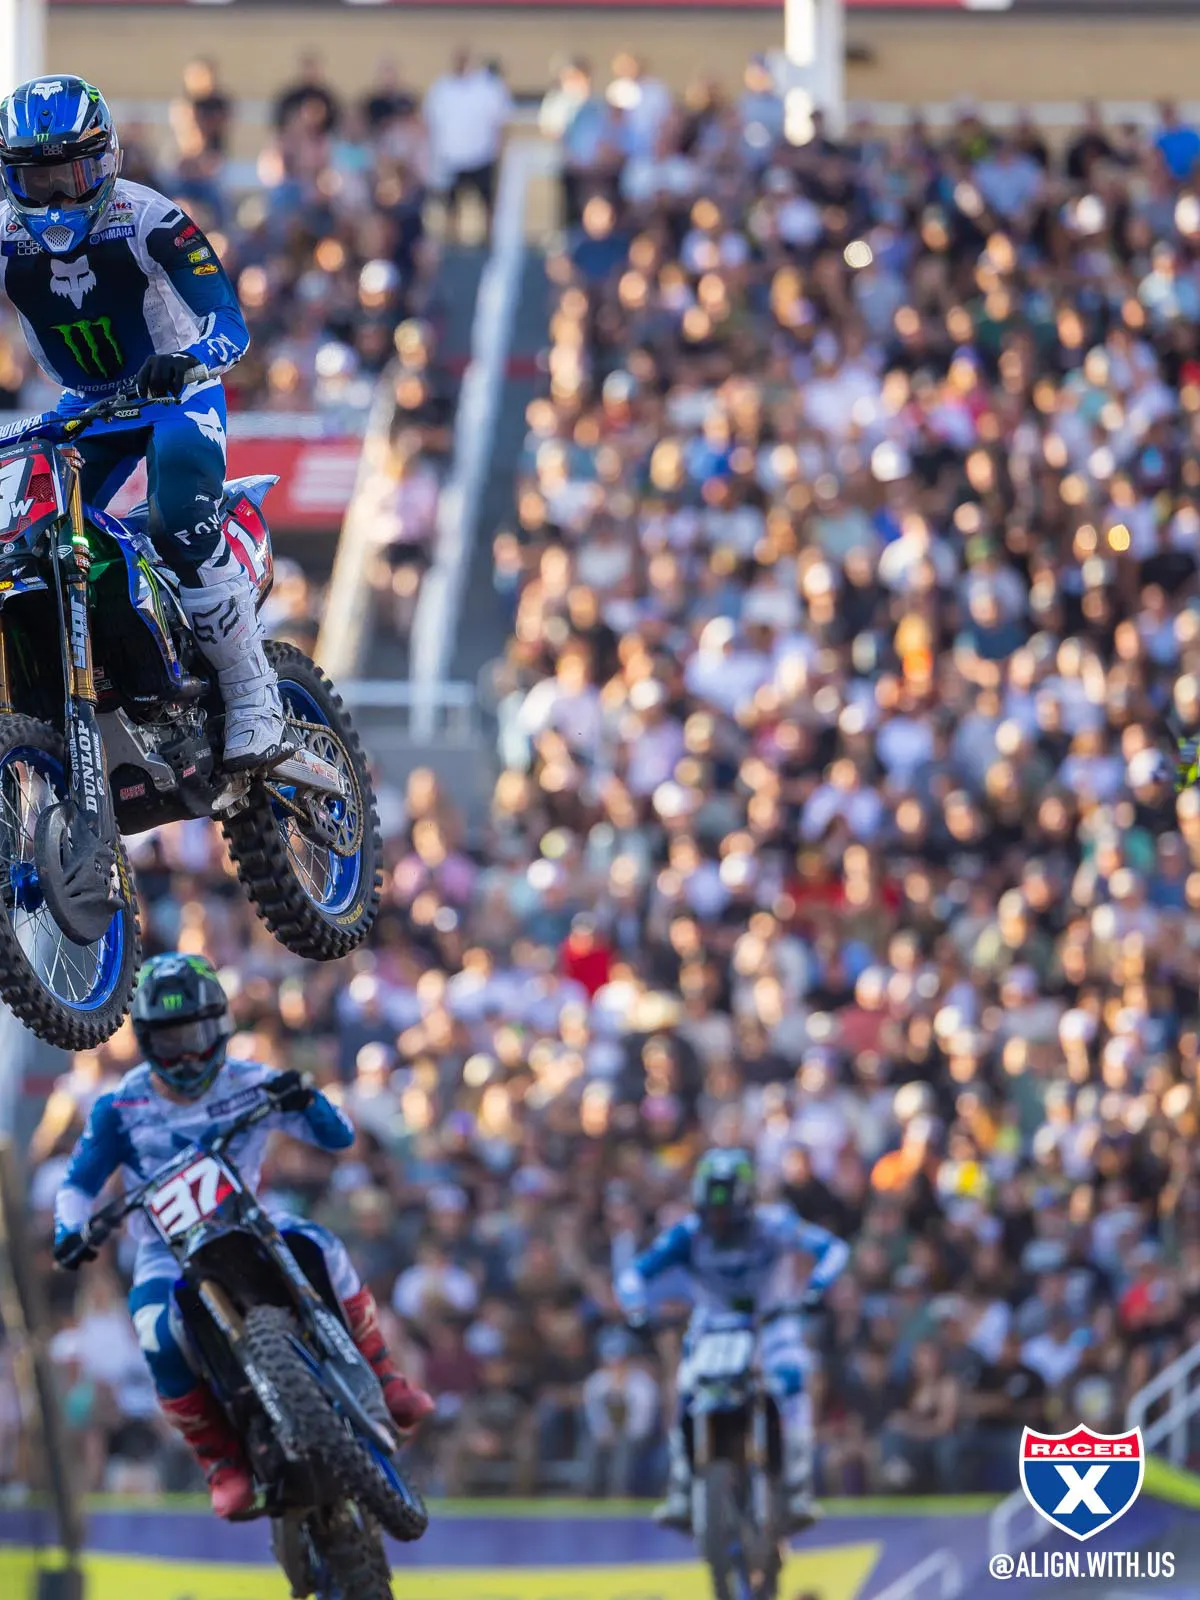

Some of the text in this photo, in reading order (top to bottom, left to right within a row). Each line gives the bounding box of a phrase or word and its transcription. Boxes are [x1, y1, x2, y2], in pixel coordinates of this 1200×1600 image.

[17, 247, 44, 256] LOCK
[99, 226, 134, 241] YAMAHA
[174, 513, 221, 546] FOX
[78, 720, 98, 814] DUNLOP
[92, 732, 102, 771] BRAKING
[151, 1156, 221, 1237] 37
